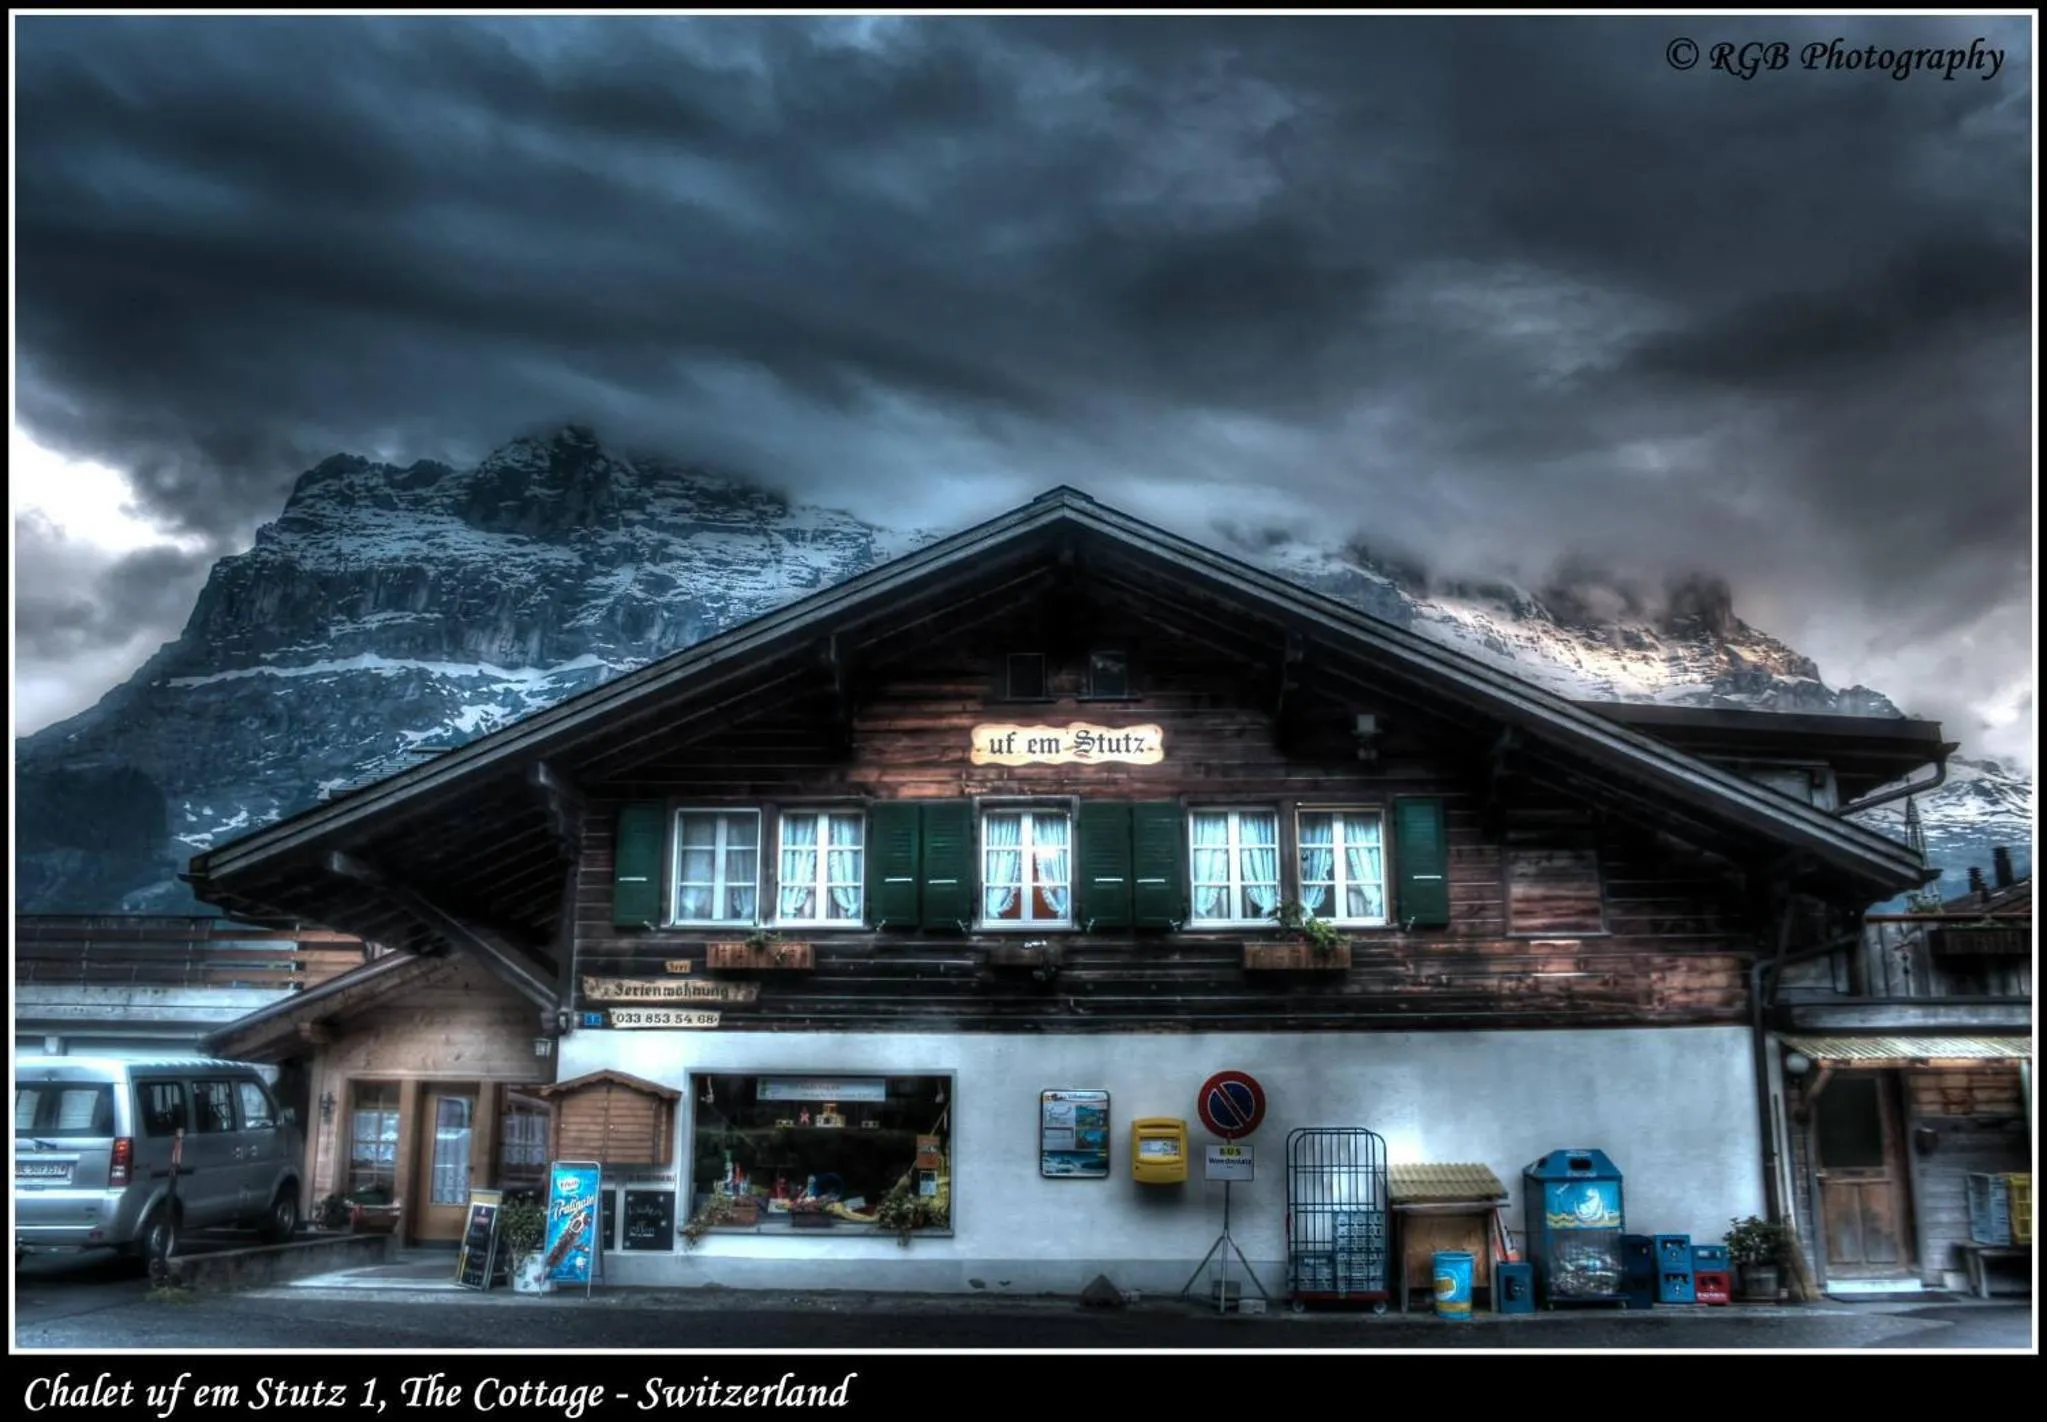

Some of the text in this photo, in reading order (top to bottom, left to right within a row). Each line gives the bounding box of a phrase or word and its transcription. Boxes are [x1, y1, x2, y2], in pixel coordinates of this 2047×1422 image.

[989, 728, 1145, 759] uf em Stutz
[614, 981, 729, 999] Ferienwohnung
[616, 1012, 641, 1024] 033
[645, 1012, 670, 1024] 853
[674, 1013, 693, 1024] 54
